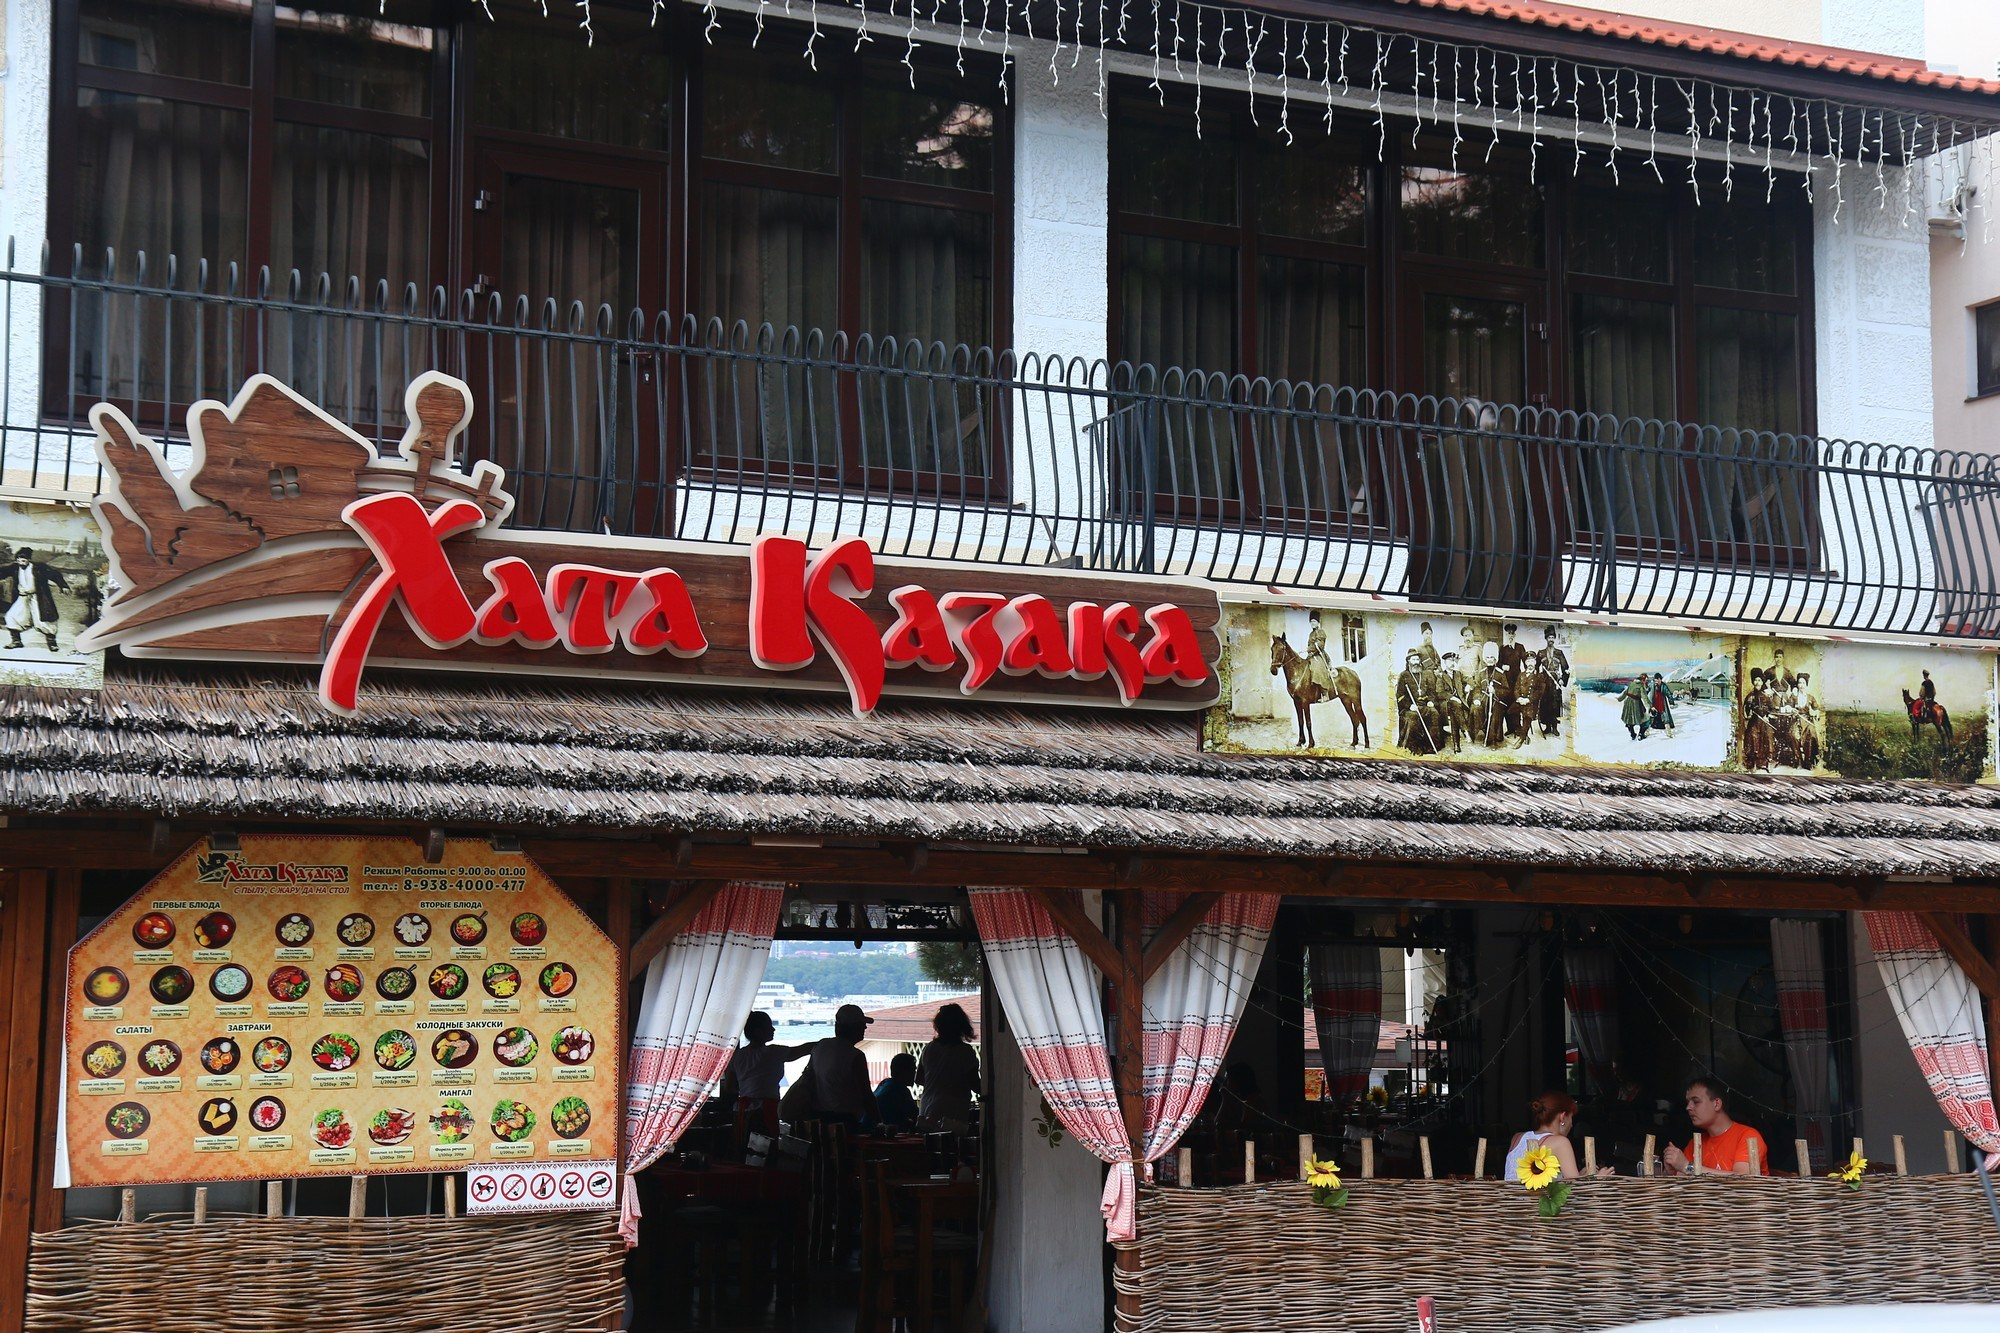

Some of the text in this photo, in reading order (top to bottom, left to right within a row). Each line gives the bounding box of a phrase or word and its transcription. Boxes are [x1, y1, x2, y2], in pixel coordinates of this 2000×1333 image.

[320, 492, 1210, 715] Хата Казака
[223, 861, 345, 888] Хата Казака
[364, 867, 401, 876] Режим
[404, 867, 447, 876] Работы
[458, 868, 481, 876] 9.00
[484, 866, 496, 876] до
[499, 867, 526, 876] 01.00
[403, 879, 525, 891] 8-938-4000-477
[240, 886, 268, 895] ПЫЛУ,
[302, 887, 314, 895] ДА
[115, 1026, 152, 1034] САЛАТЫ
[228, 1024, 272, 1032] ЗАВТРАКИ
[416, 1021, 463, 1030] ХОЛОДНЫЕ
[439, 1089, 472, 1097] МАНГАЛ
